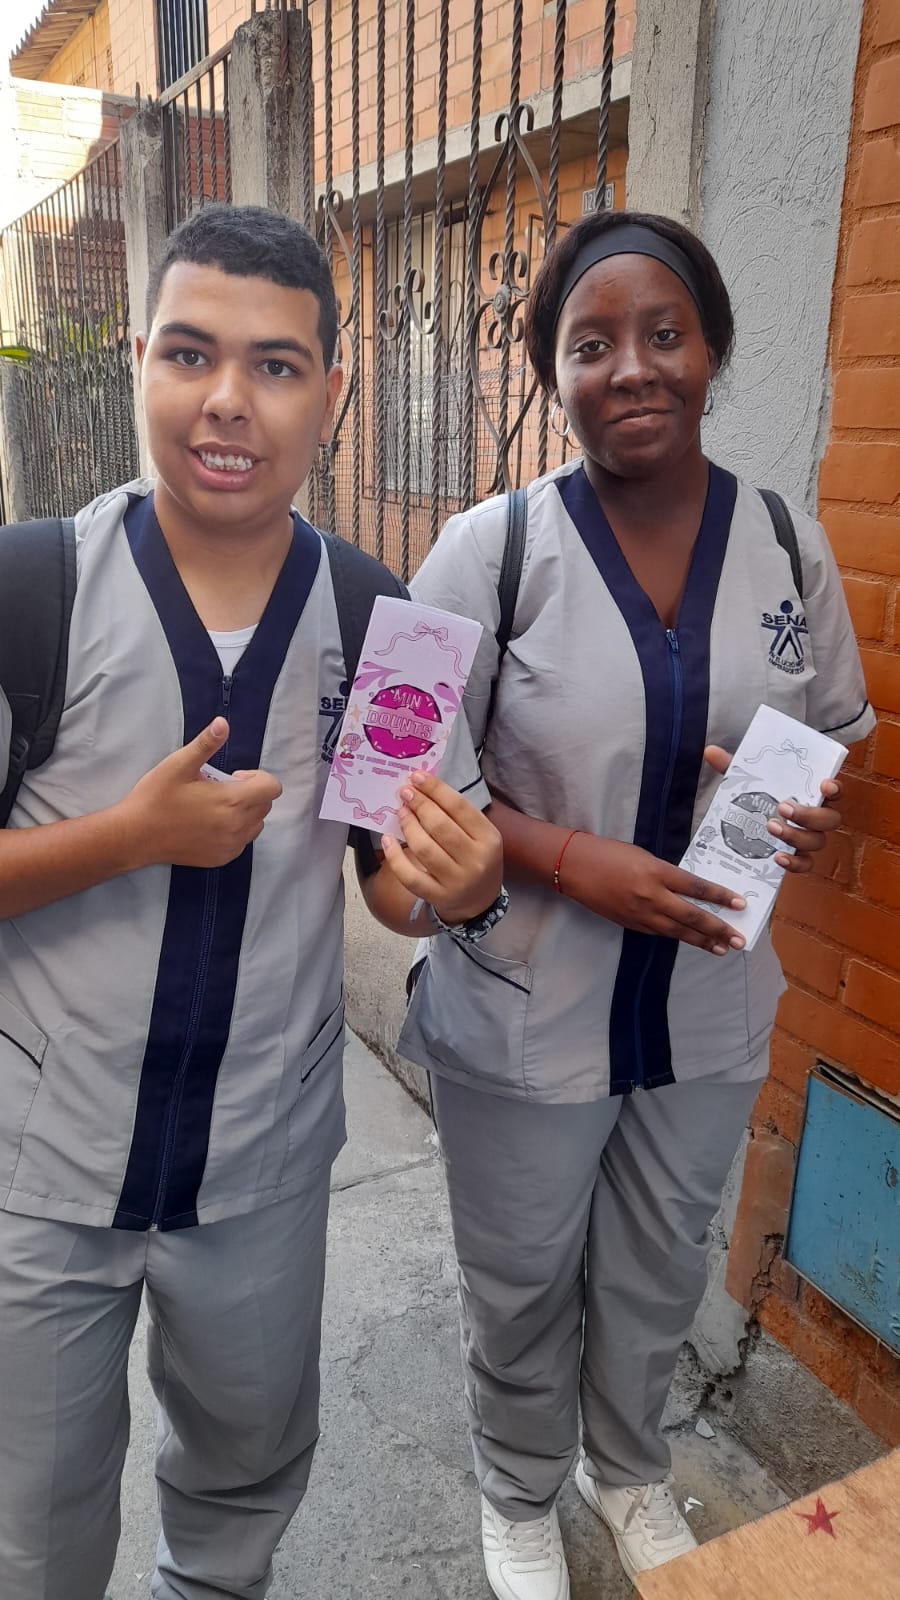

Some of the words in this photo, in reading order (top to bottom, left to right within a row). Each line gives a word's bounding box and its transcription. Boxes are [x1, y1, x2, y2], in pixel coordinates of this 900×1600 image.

[762, 613, 807, 627] SENA
[320, 696, 348, 711] SE
[393, 688, 421, 709] MIN
[366, 709, 433, 739] DOUNTS
